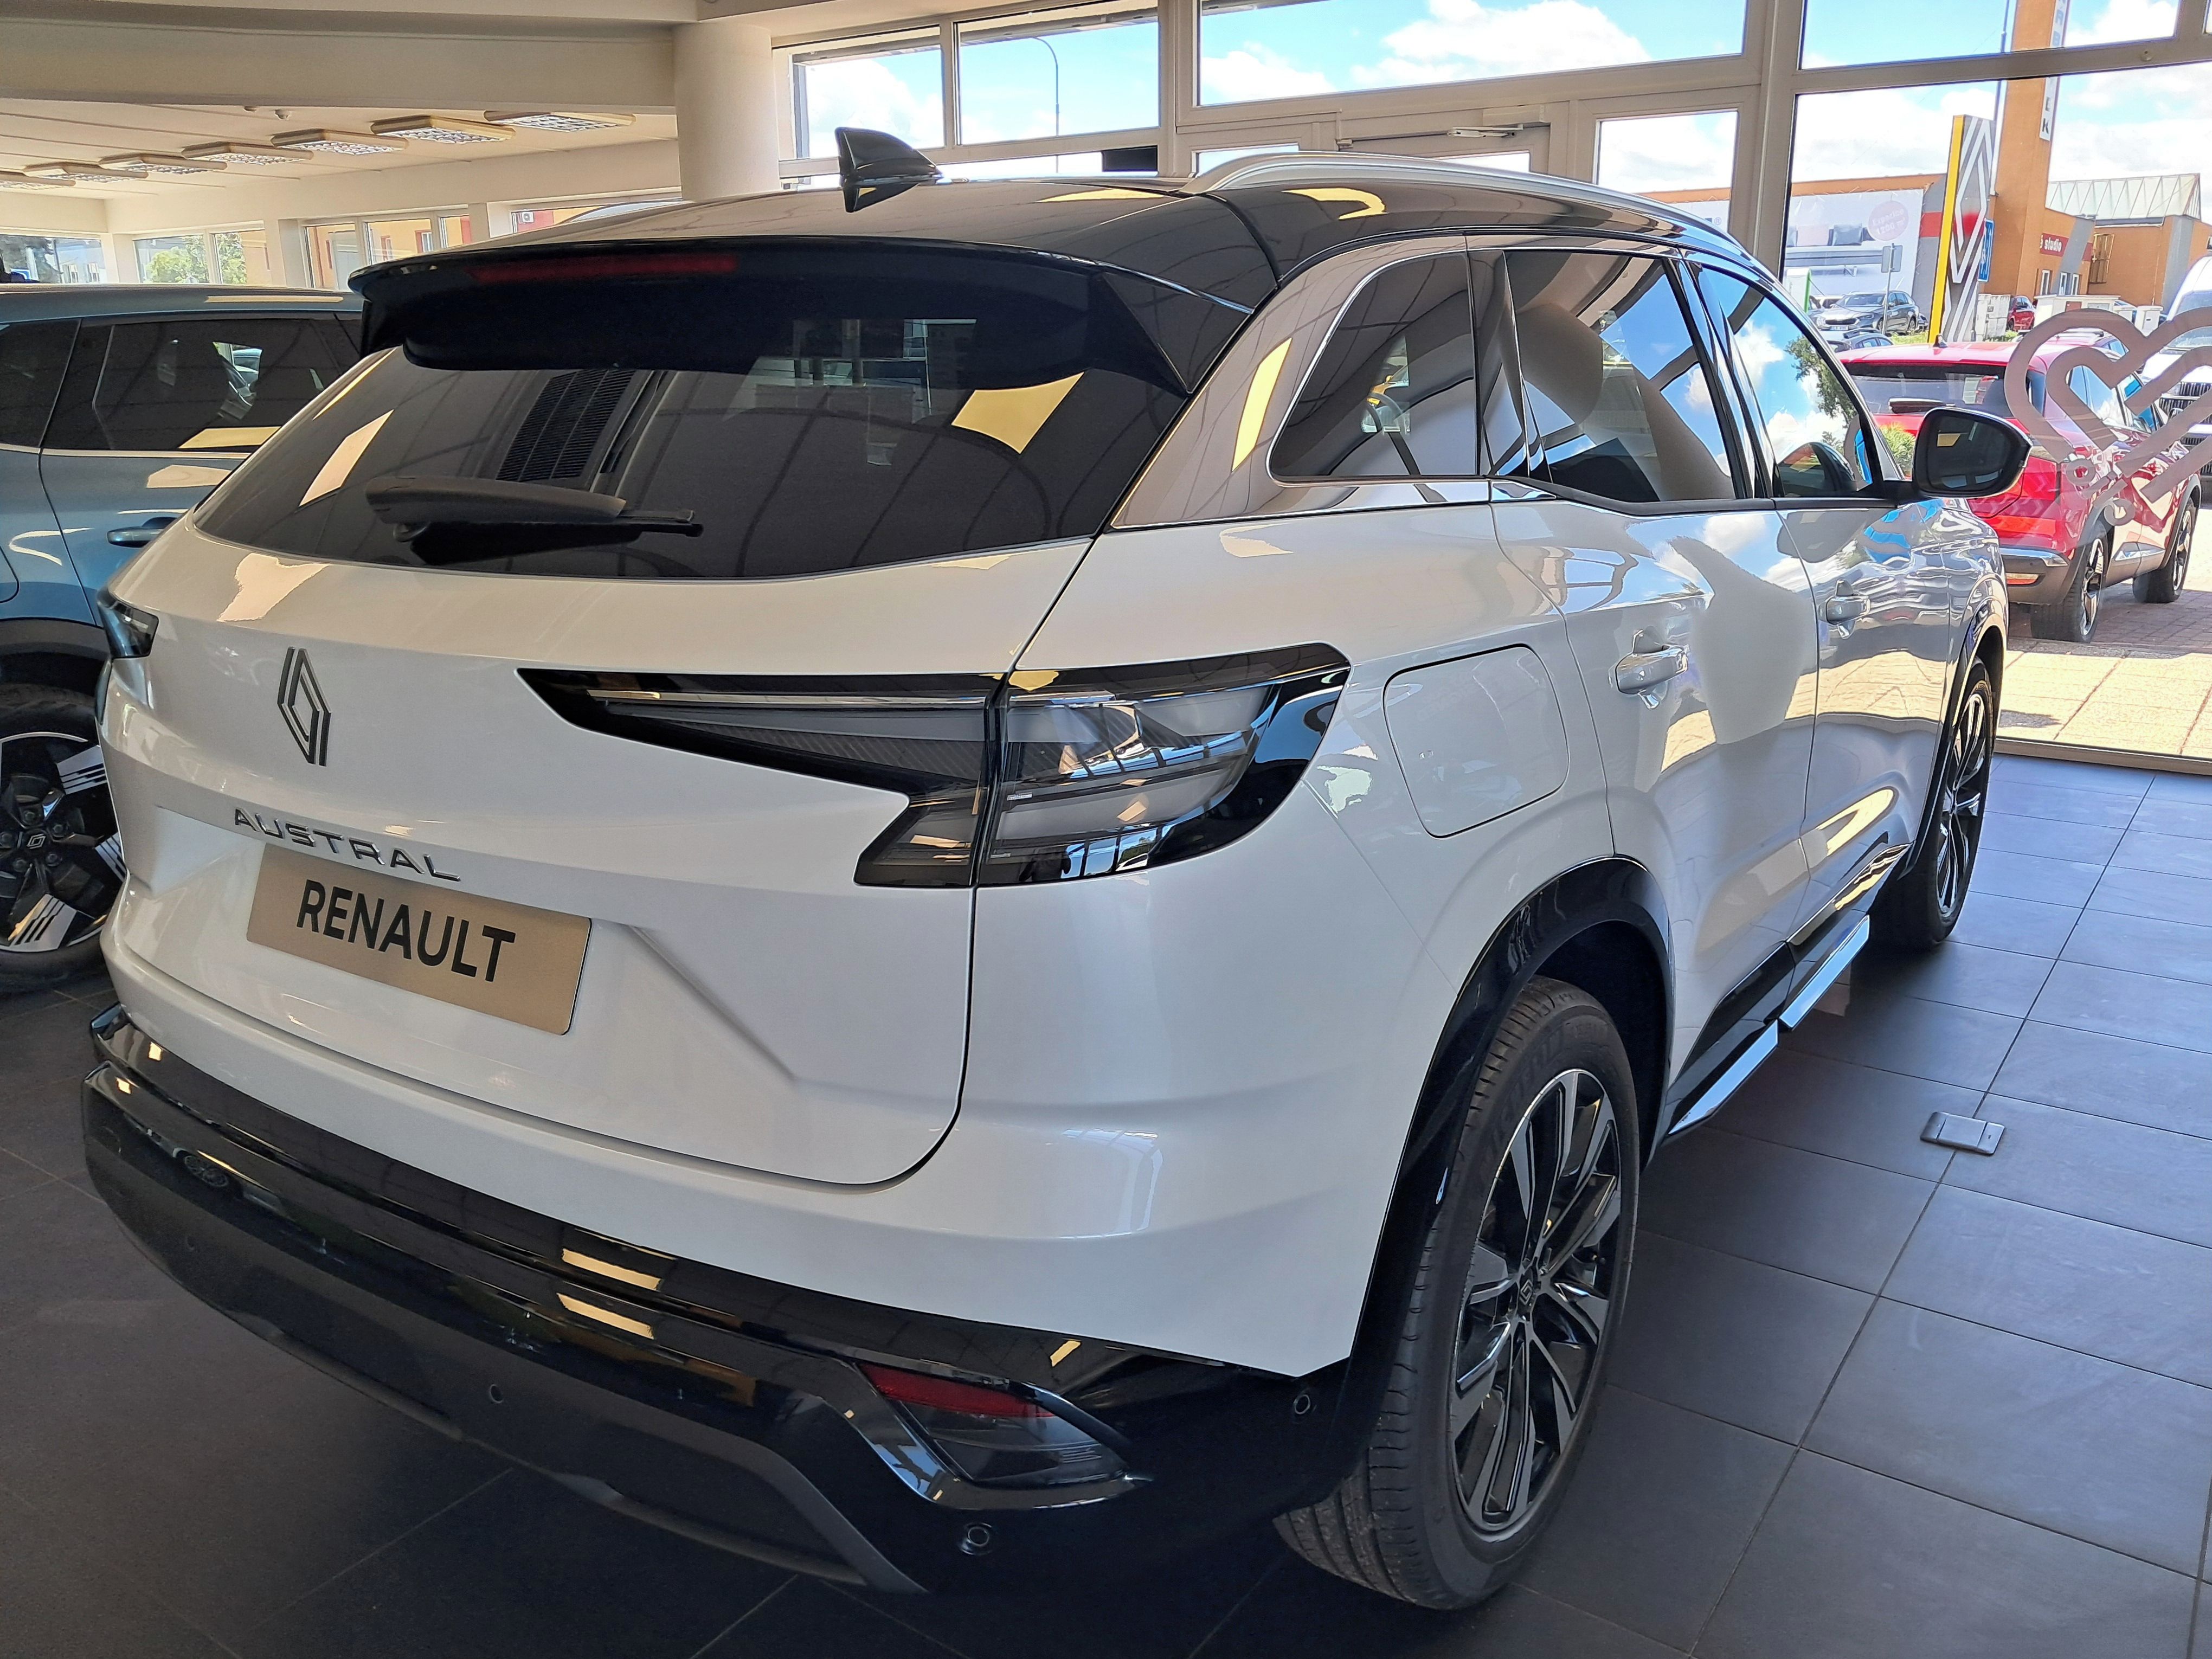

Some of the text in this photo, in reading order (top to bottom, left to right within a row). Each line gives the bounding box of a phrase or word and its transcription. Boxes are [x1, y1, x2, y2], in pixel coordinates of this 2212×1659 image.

[2044, 237, 2062, 252] studio
[234, 807, 461, 882] AUSTRAL
[296, 879, 516, 983] RENAULT
